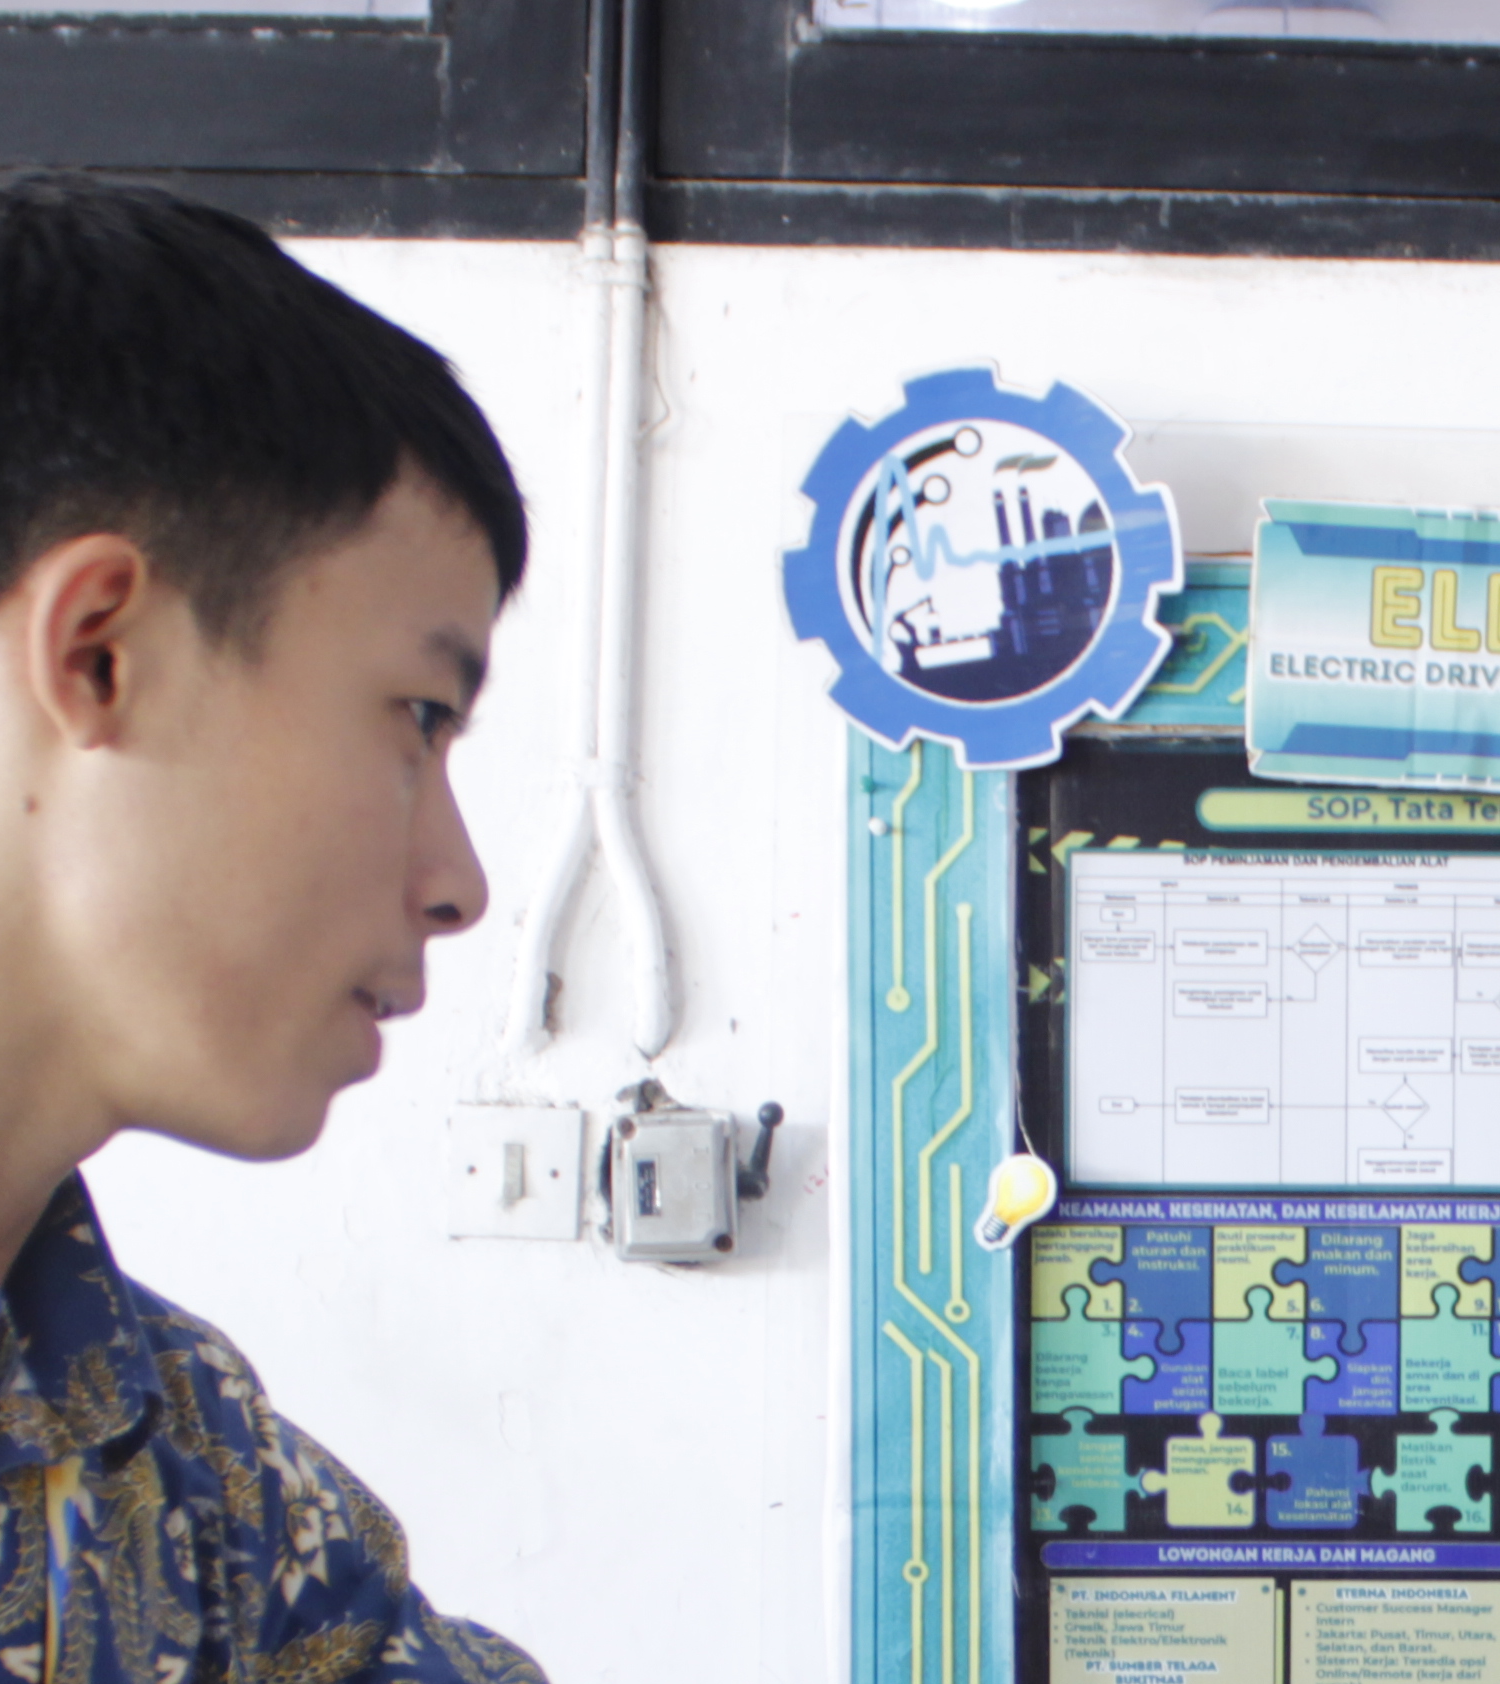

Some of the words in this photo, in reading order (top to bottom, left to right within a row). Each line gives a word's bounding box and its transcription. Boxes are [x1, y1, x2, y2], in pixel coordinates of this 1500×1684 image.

[1269, 654, 1414, 686] ELECTRIC
[1308, 796, 1376, 824] SOP,
[1388, 797, 1454, 820] Tata
[1058, 1203, 1164, 1219] KEAMANAN,
[1169, 1203, 1276, 1220] KESEHATAN,
[1281, 1204, 1320, 1220] DAN
[1324, 1204, 1450, 1221] KESELAMATAN
[1146, 1231, 1192, 1243] Patuhi
[1321, 1233, 1383, 1249] Dilarang
[1131, 1246, 1175, 1257] aturan
[1178, 1245, 1207, 1257] dan
[1311, 1249, 1362, 1260] makan
[1365, 1249, 1393, 1260] dan
[1406, 1243, 1475, 1254] kebersihan
[1137, 1259, 1200, 1271] instruksi.
[1324, 1263, 1379, 1275] minum.
[1128, 1298, 1143, 1312] 2.
[1310, 1298, 1324, 1312] 6.
[1400, 1442, 1453, 1453] Matikan
[1400, 1455, 1437, 1466] listrik
[1158, 1547, 1257, 1563] LOWONGAN
[1262, 1547, 1315, 1563] KERJA
[1320, 1547, 1356, 1563] DAN
[1360, 1547, 1435, 1564] MAGANG
[1336, 1589, 1385, 1599] ETERNA
[1391, 1589, 1468, 1599] INDONESIA
